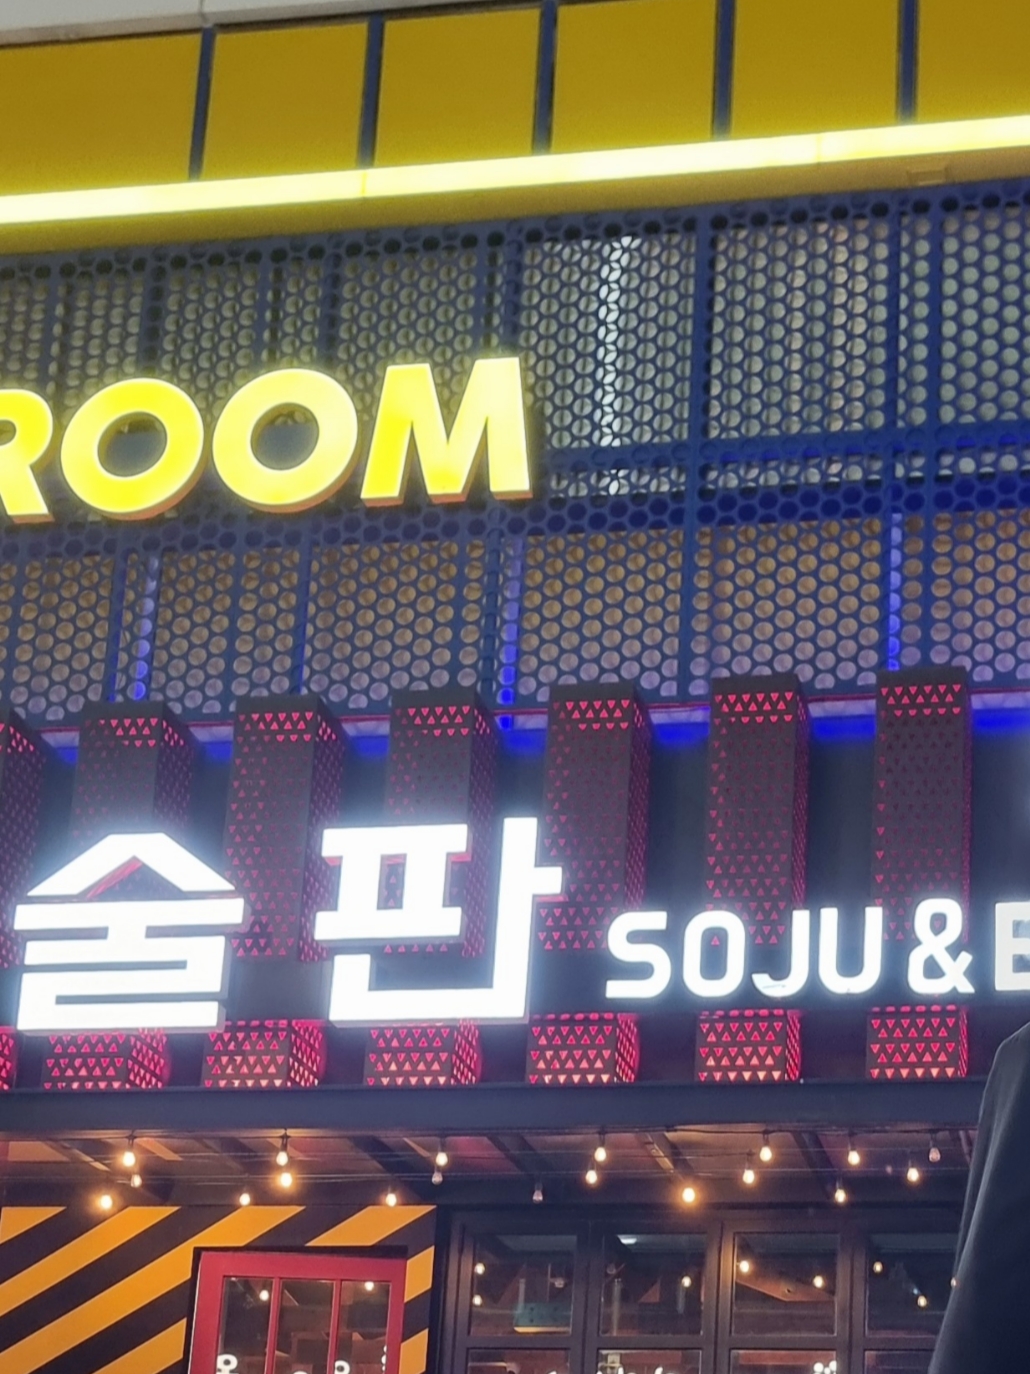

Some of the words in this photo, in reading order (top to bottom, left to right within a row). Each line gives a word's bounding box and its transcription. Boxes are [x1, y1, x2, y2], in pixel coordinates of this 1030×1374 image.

[14, 817, 563, 1031] 술판
[605, 905, 884, 998] SOJU
[907, 898, 975, 995] &
